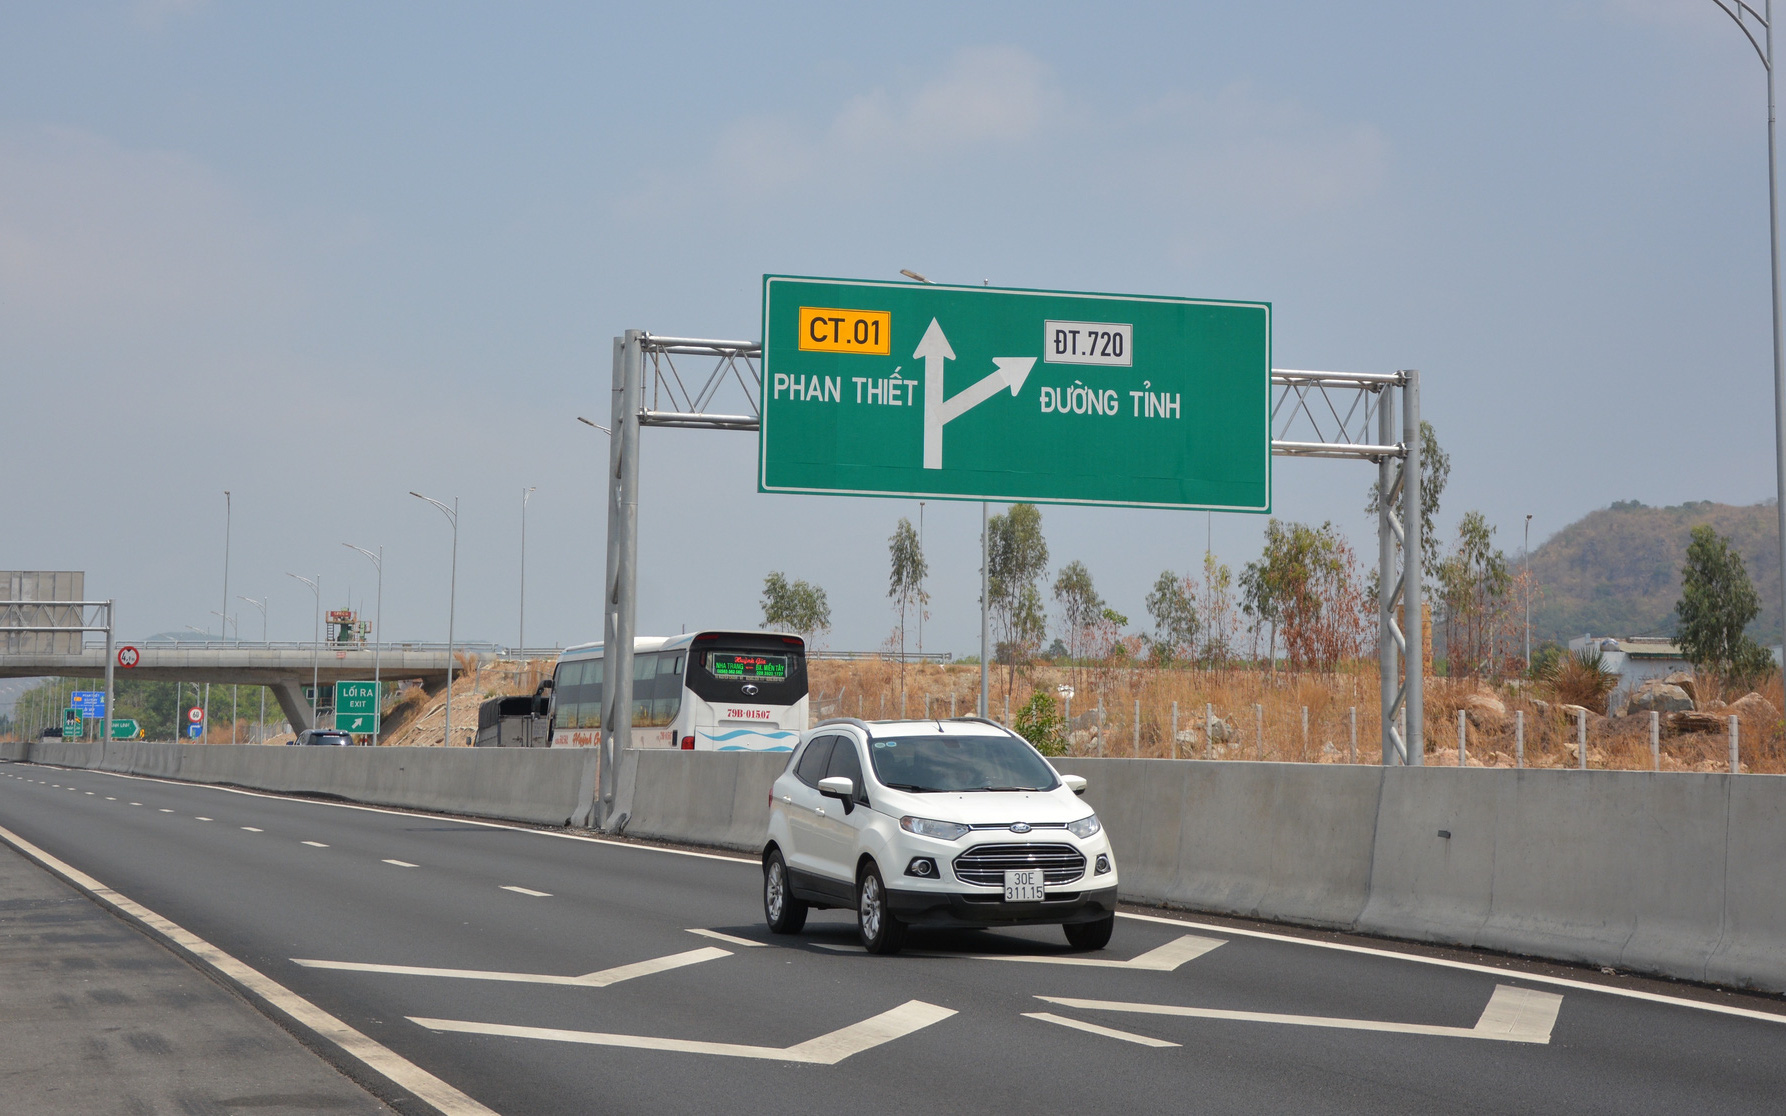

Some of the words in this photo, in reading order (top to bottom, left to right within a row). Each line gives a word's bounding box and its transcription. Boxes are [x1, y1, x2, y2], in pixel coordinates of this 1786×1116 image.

[810, 316, 880, 346] CT.01
[1053, 329, 1124, 358] ĐT.720
[773, 372, 842, 403] PHAN
[851, 365, 919, 406] THIẾT
[1039, 379, 1119, 416] ĐƯỜNG
[1129, 379, 1181, 419] TỈNH
[343, 685, 358, 697] LỐI
[360, 688, 374, 697] RA
[349, 700, 367, 708] EXIT
[192, 710, 200, 718] 60
[1014, 872, 1035, 886] 30E
[1006, 886, 1043, 900] 311.15
